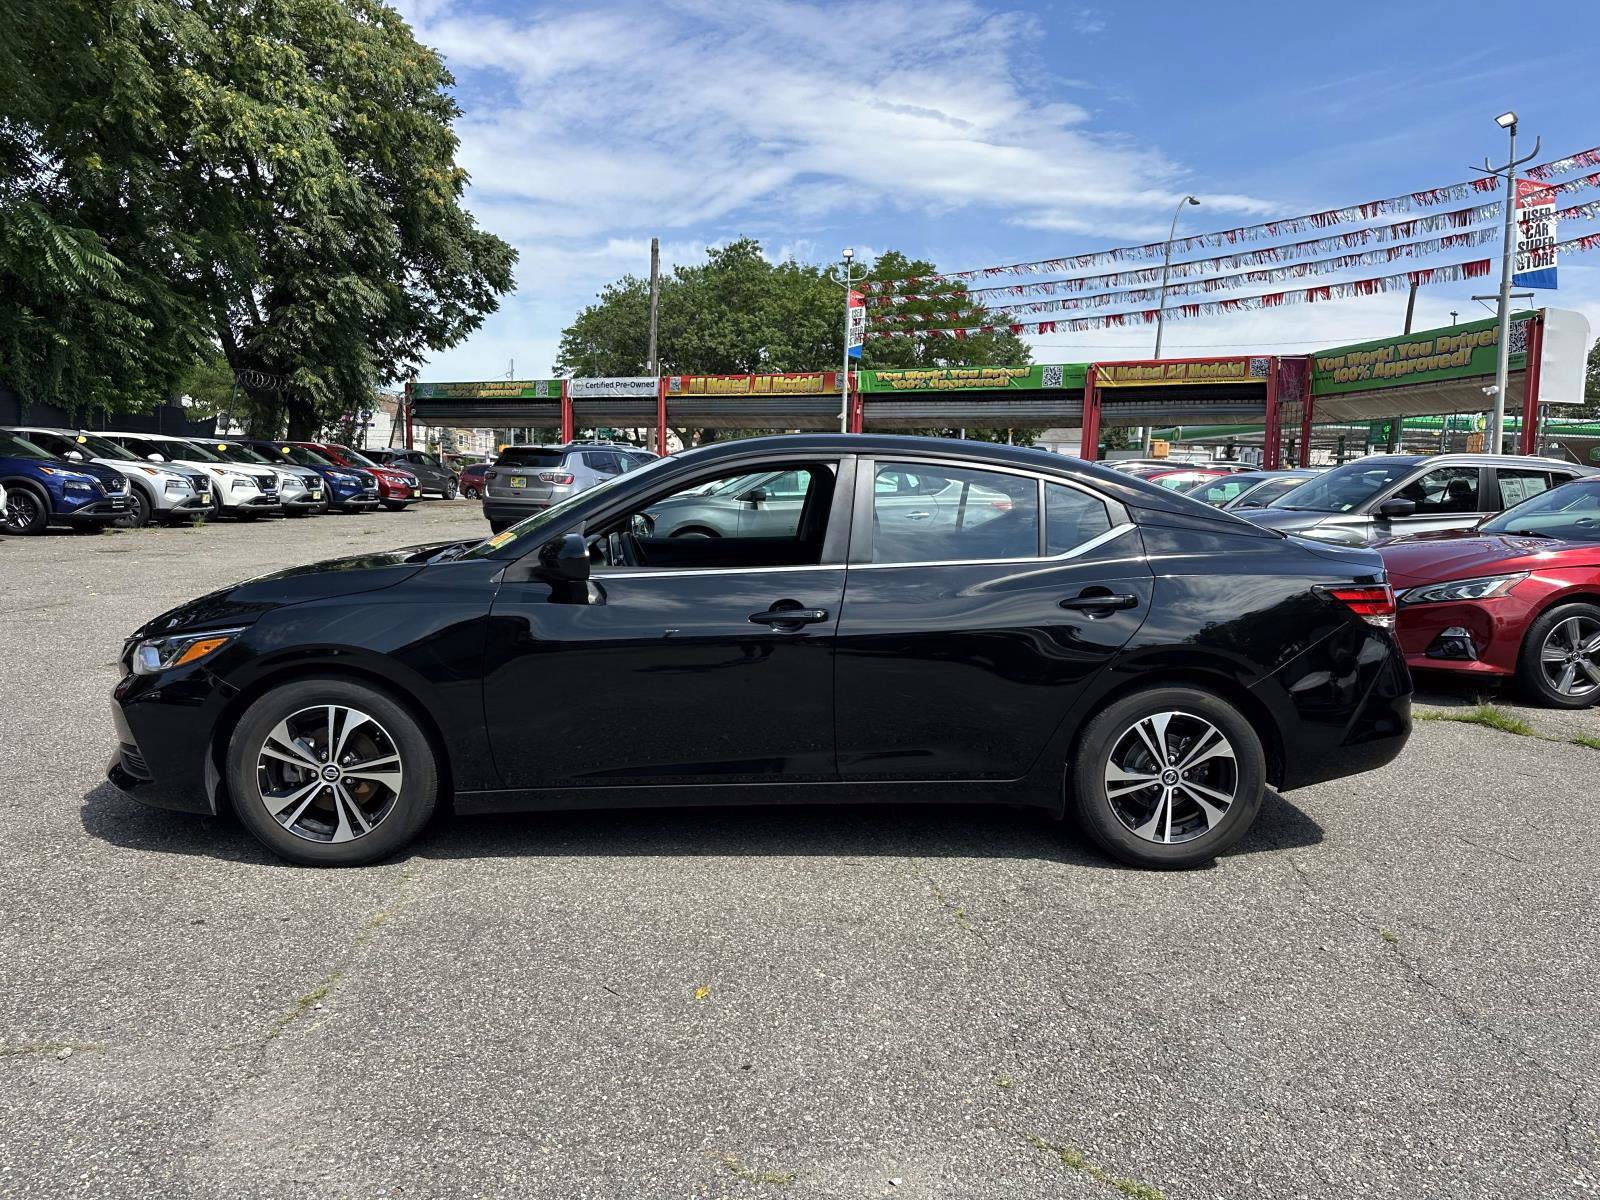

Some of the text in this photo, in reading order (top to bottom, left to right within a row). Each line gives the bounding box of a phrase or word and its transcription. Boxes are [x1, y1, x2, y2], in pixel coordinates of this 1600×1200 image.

[1522, 207, 1551, 223] USED
[1525, 222, 1549, 240] CAR
[1316, 325, 1500, 372] You Work! You Drive!
[875, 366, 1031, 381] You Work! You Drive!
[1115, 364, 1165, 381] Makes!
[1166, 363, 1187, 379] All
[1187, 361, 1246, 378] Models!
[1333, 347, 1473, 384] 100% Approved!
[615, 381, 655, 389] Pre-Owned
[688, 374, 824, 394] All Makes! All Models!
[891, 377, 1010, 390] 100% Approved!
